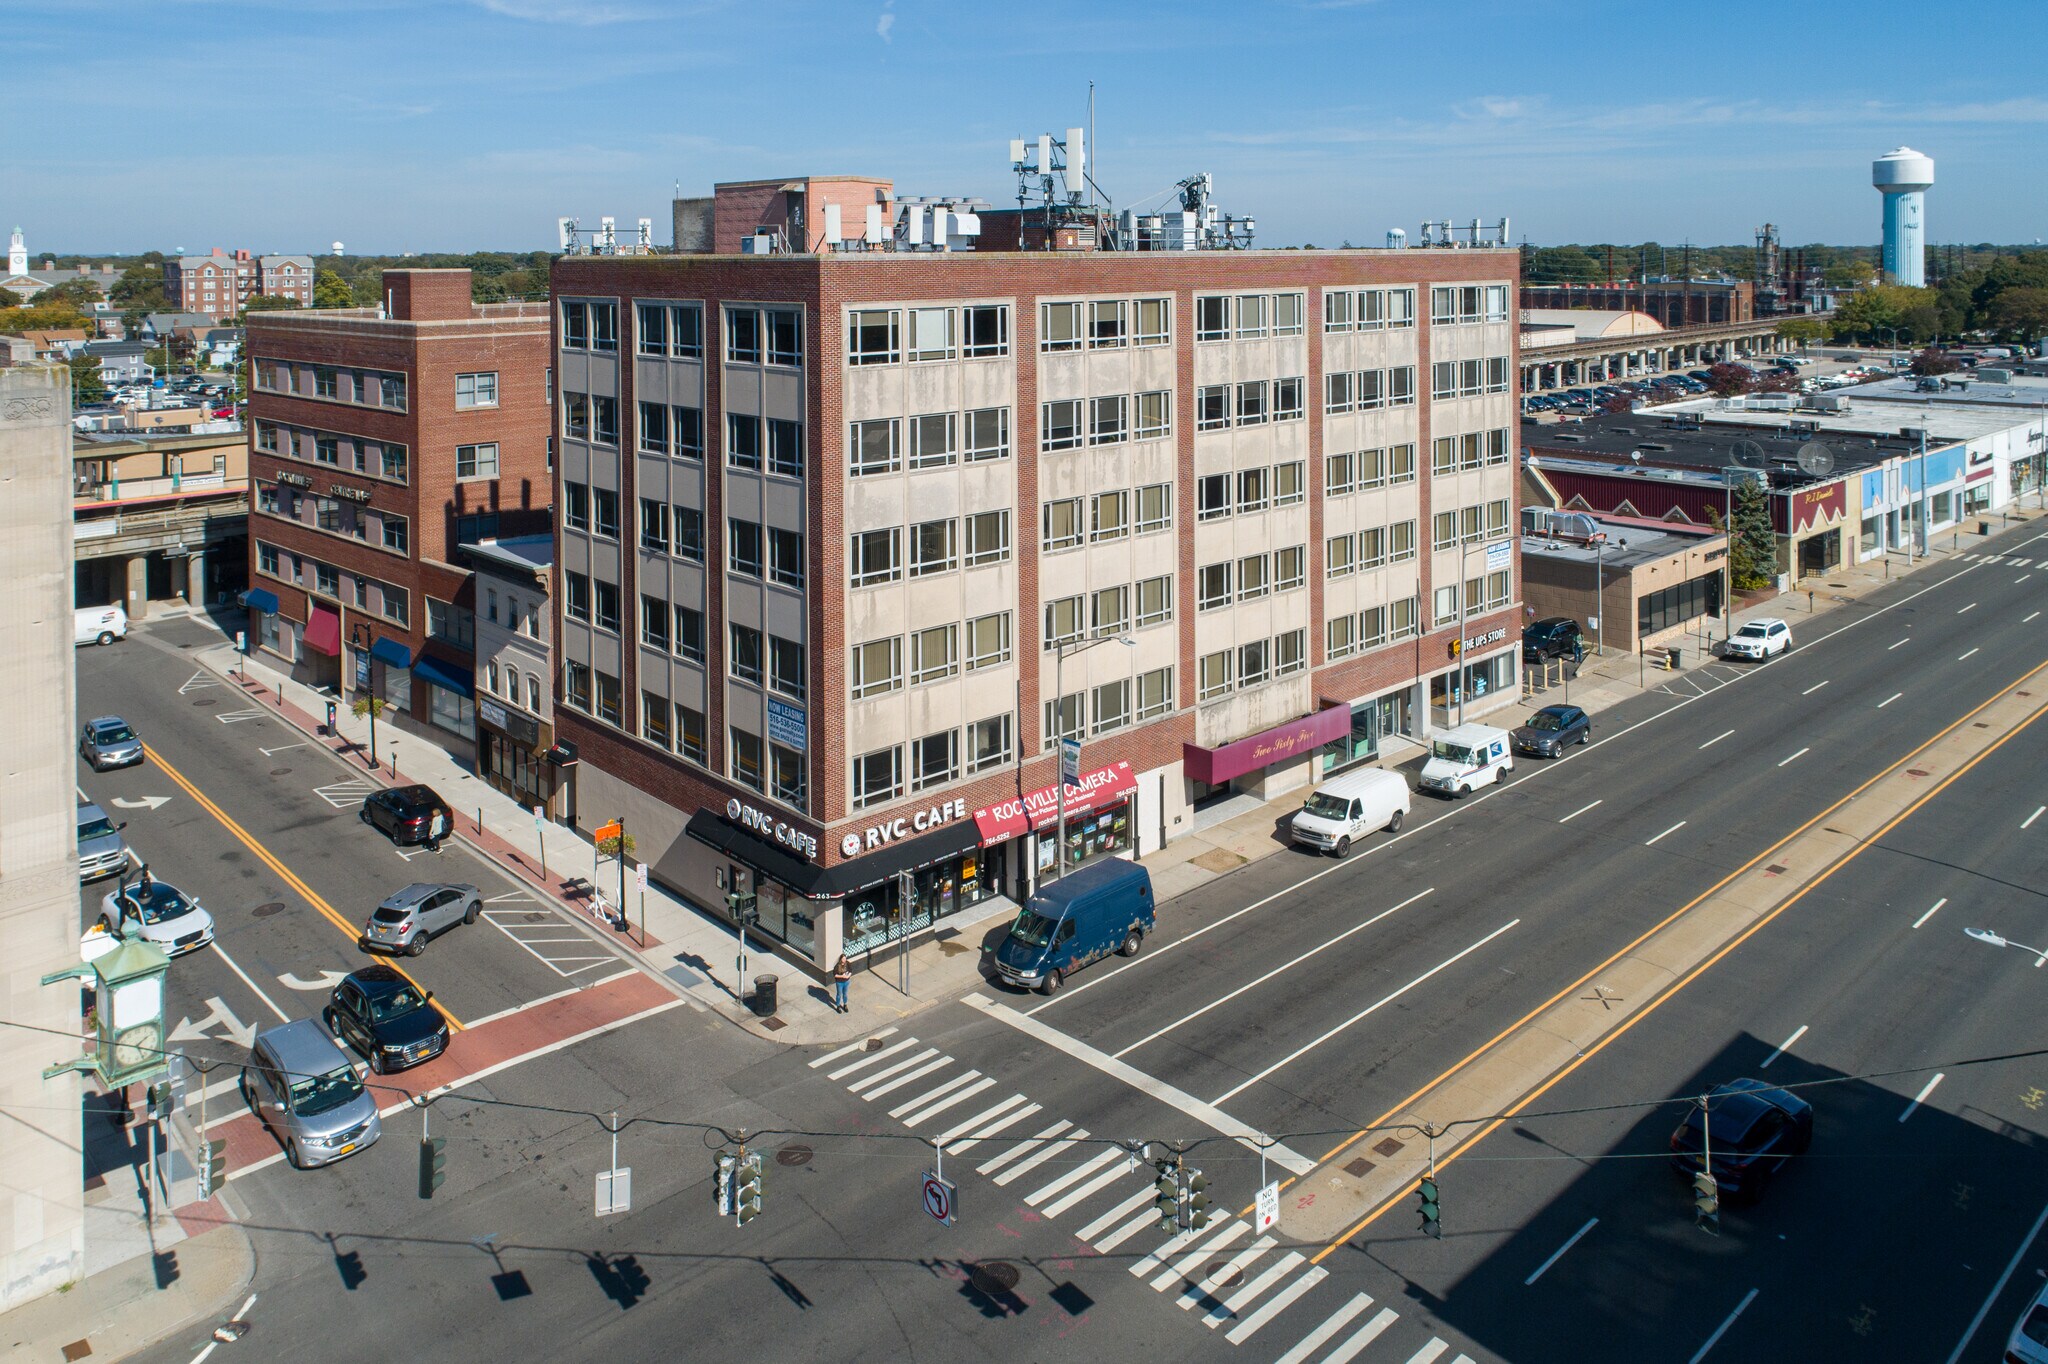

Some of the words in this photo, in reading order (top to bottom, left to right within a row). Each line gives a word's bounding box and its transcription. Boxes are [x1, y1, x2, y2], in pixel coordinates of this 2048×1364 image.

[1464, 638, 1474, 650] THE
[1475, 634, 1486, 646] UPS
[1488, 628, 1506, 643] STORE
[768, 700, 781, 714] NOW
[781, 704, 804, 723] LEASING
[1253, 744, 1271, 758] Two
[1273, 735, 1295, 752] Sixty
[1296, 729, 1315, 743] Five
[1118, 761, 1128, 770] 265
[1063, 768, 1118, 797] CAMERA
[866, 818, 907, 848] RVC
[914, 798, 966, 831] CAFE
[975, 810, 987, 819] 265
[742, 805, 772, 835] RVC
[775, 822, 817, 858] CAFE
[985, 832, 1010, 846] 764-5252
[960, 881, 979, 894] FILM
[1261, 1196, 1275, 1209] TURN
[1263, 1189, 1273, 1200] NO
[1258, 1210, 1265, 1220] ON
[1267, 1203, 1277, 1214] RED
